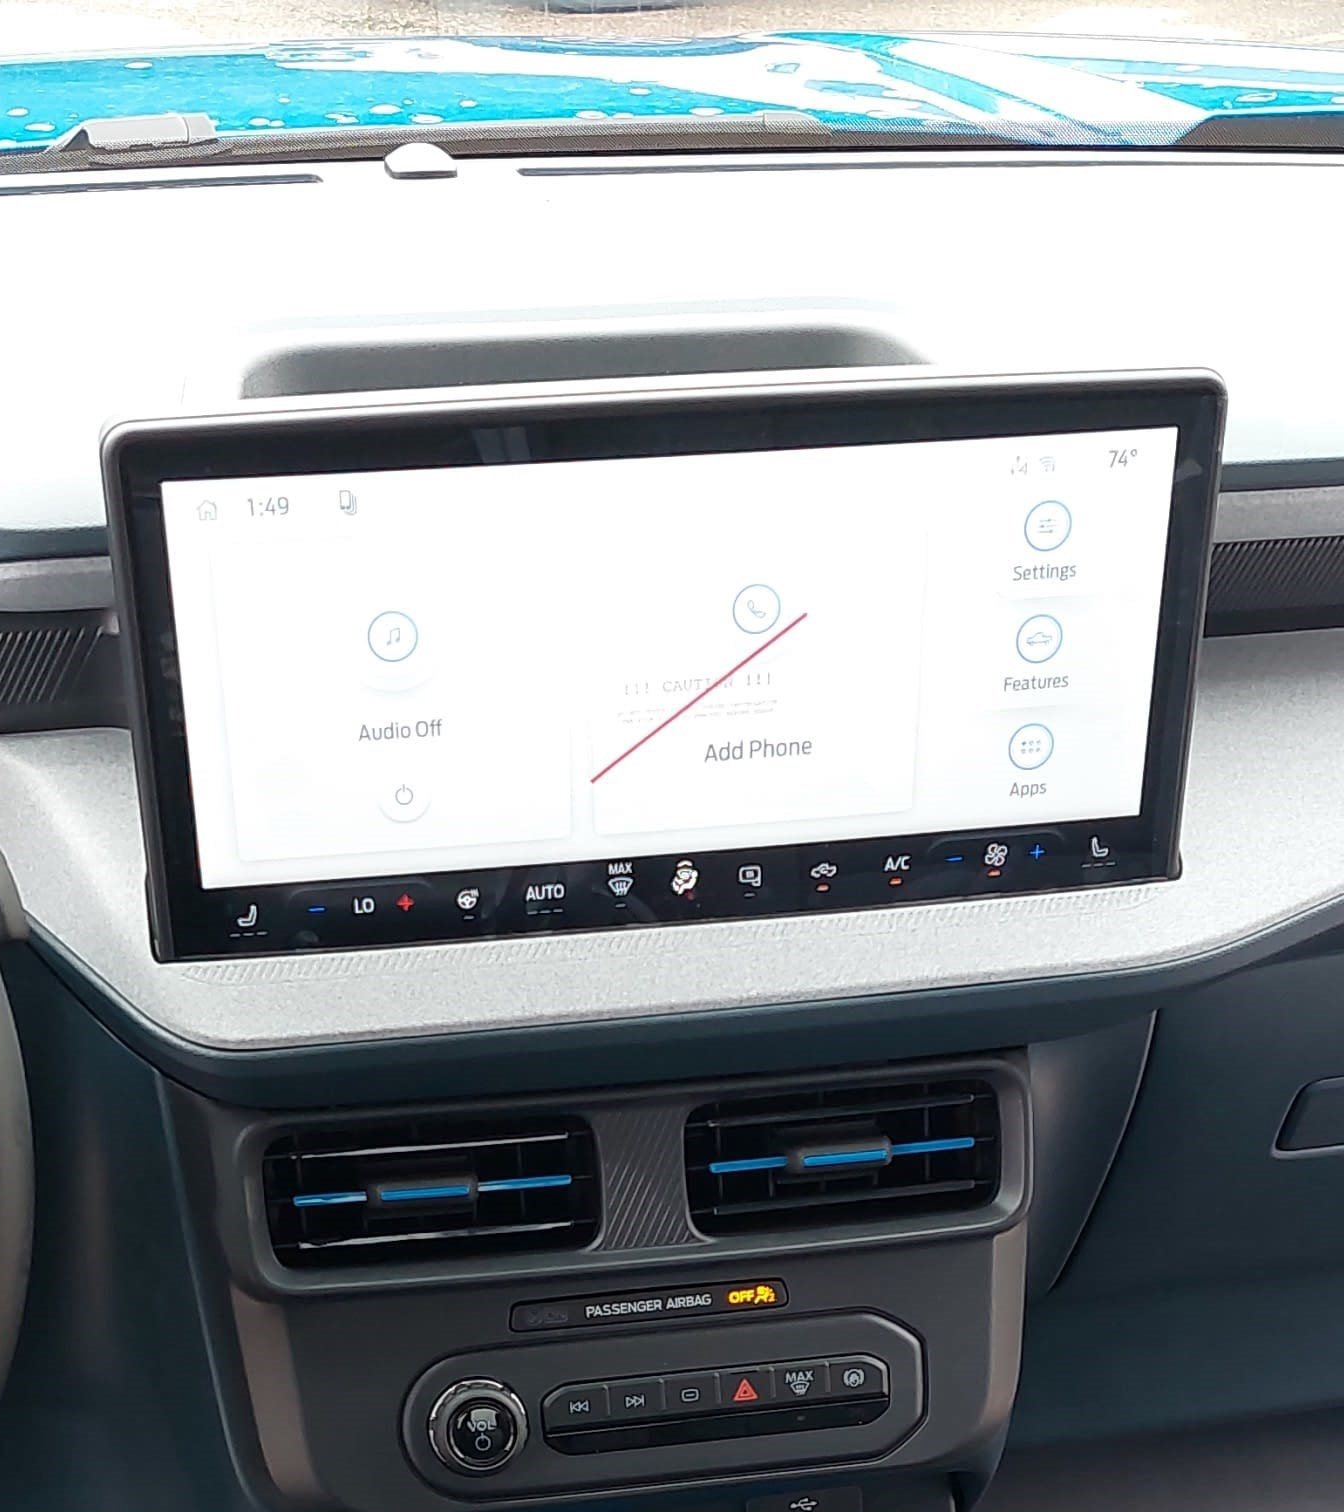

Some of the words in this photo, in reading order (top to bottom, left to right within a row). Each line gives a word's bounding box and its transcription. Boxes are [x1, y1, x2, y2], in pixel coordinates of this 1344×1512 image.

[1108, 448, 1138, 469] 74°
[247, 497, 289, 517] 1:49
[1012, 562, 1077, 582] Settings
[1003, 673, 1069, 692] Features
[358, 720, 411, 742] Audio
[415, 719, 443, 738] Off
[704, 742, 745, 763] Add
[749, 737, 812, 760] Phone
[1009, 780, 1047, 799] Apps
[607, 862, 633, 876] MAX
[884, 856, 911, 872] A/C
[526, 884, 564, 902] AUTO
[353, 897, 374, 914] LO
[586, 1299, 663, 1319] PASSENGER
[666, 1294, 712, 1310] AIRBAG
[728, 1291, 754, 1304] OFF
[785, 1371, 814, 1384] MAX
[467, 1420, 496, 1433] VOL
